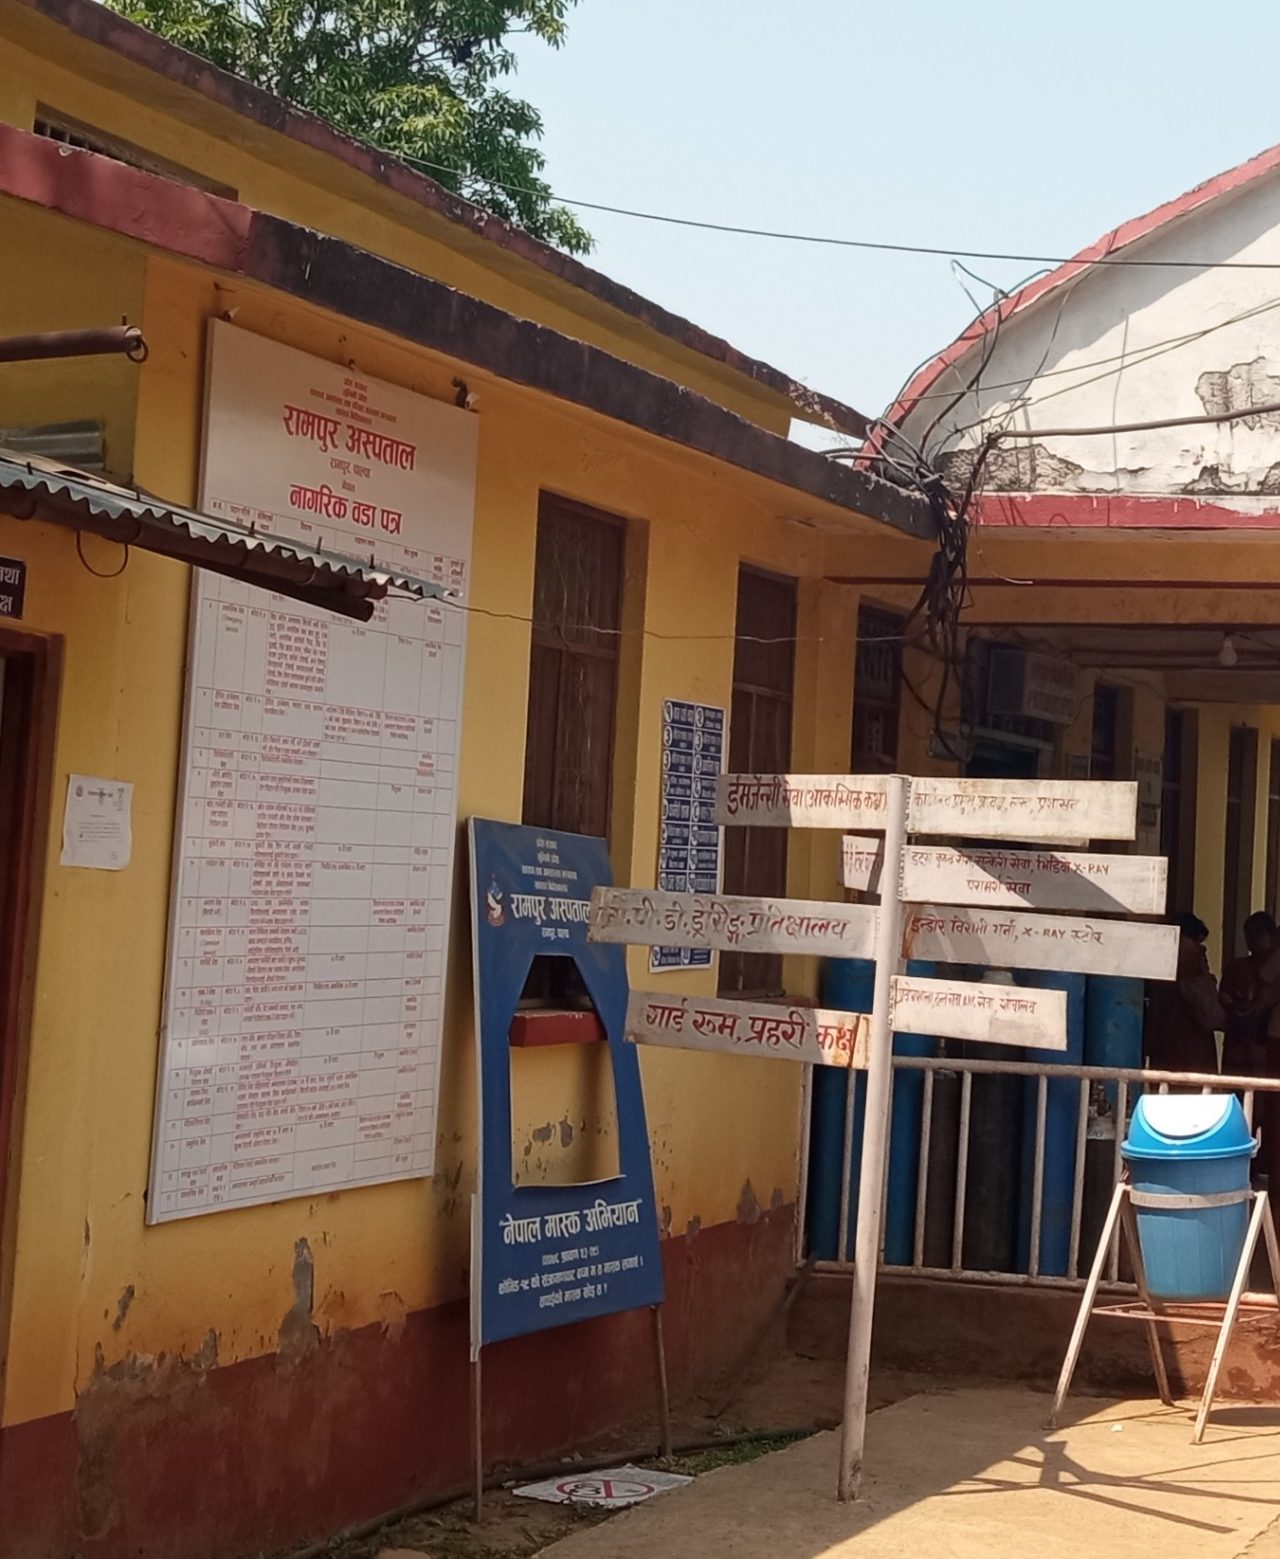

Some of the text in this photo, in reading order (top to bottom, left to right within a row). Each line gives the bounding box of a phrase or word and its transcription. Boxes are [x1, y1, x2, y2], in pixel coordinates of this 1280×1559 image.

[282, 404, 341, 453] रामपुर
[345, 424, 417, 471] अस्पताल
[289, 484, 403, 535] नागरिक वडा पत्र
[0, 565, 21, 585] था
[1004, 875, 1033, 896] सेवा
[510, 893, 547, 925] रामपुर
[744, 1009, 810, 1049] प्रहरी
[815, 1024, 856, 1052] कक्ष
[545, 1211, 581, 1238] मास्क
